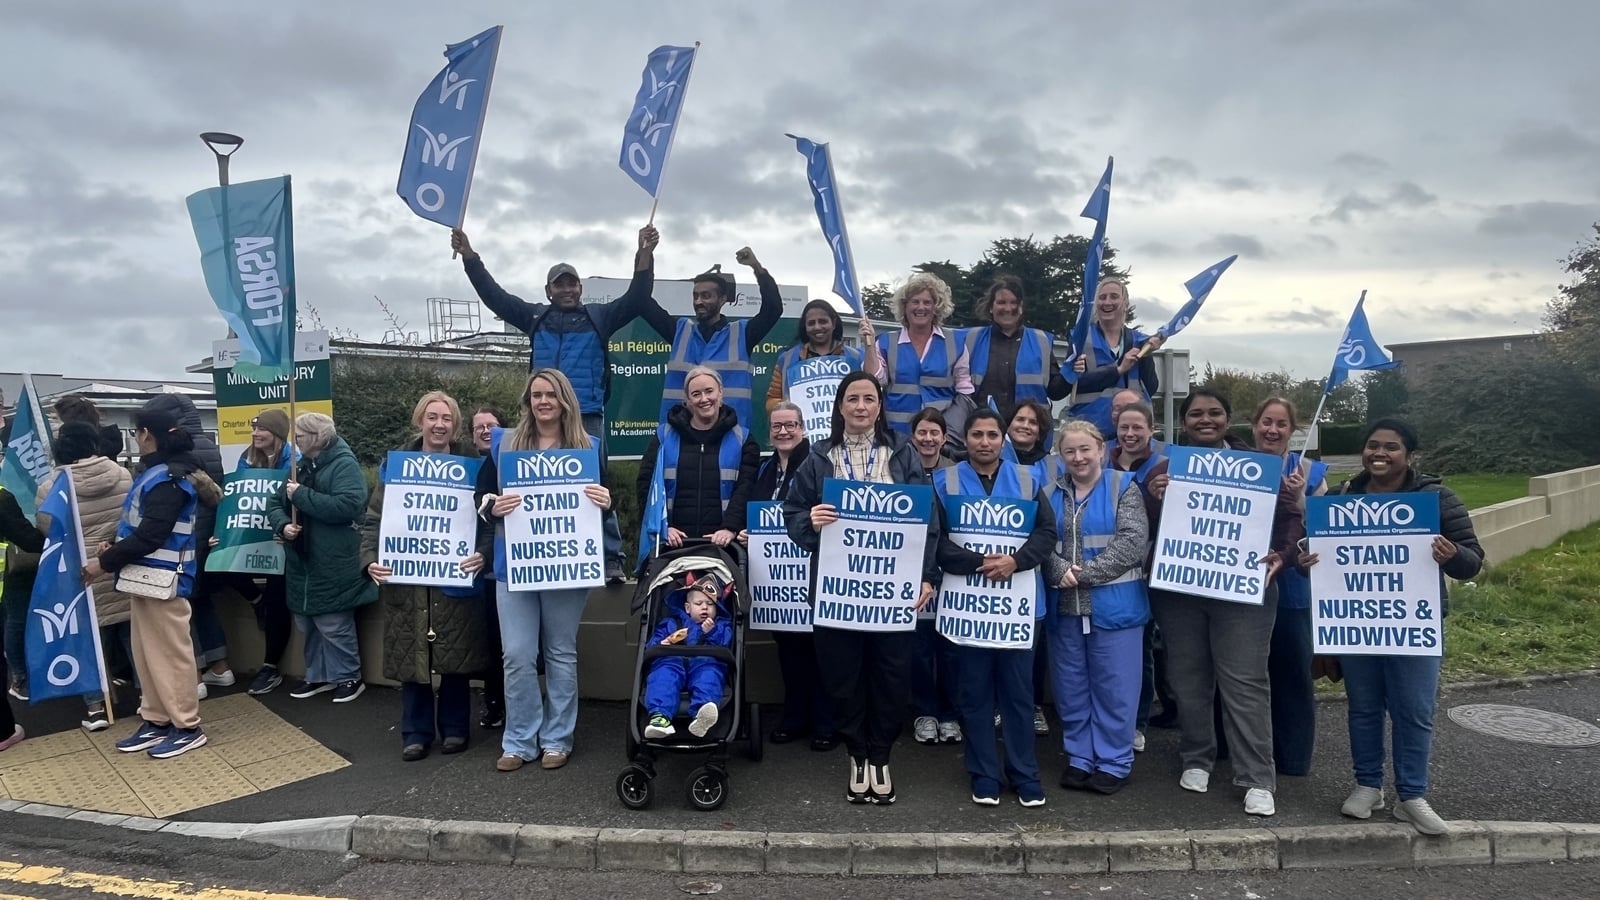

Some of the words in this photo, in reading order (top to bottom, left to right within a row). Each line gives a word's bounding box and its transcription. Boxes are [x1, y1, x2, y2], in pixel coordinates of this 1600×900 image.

[628, 341, 672, 354] Réigiún
[610, 364, 660, 377] Regional
[800, 359, 851, 378] INMO
[259, 385, 288, 400] UNIT
[806, 385, 838, 399] STAN
[812, 400, 834, 413] WI
[402, 454, 466, 481] INMO
[517, 452, 583, 479] INMO
[1188, 451, 1263, 481] INMO
[238, 496, 267, 511] ON
[403, 492, 458, 512] STAND
[523, 492, 580, 512] STAND
[841, 485, 913, 515] INMO
[1187, 491, 1252, 517] STAND
[960, 498, 1025, 528] INMO
[1329, 497, 1415, 527] INMO
[407, 515, 451, 534] WITH
[530, 516, 576, 535] WITH
[1191, 516, 1242, 541] WITH
[385, 537, 450, 556] NURSES
[456, 540, 469, 557] &
[511, 539, 578, 560] NURSES
[585, 538, 598, 556] &
[843, 528, 904, 550] STAND
[245, 548, 279, 570] FÓRSA
[848, 553, 896, 575] WITH
[1162, 538, 1239, 567] NURSES
[1245, 551, 1260, 571] &
[1336, 544, 1410, 566] STAND
[382, 559, 470, 580] MIDWIVES
[511, 562, 601, 585] MIDWIVES
[769, 564, 806, 581] WITH
[1156, 563, 1260, 595] MIDWIVES
[822, 576, 895, 600] NURSES
[901, 582, 914, 600] &
[1344, 572, 1404, 592] WITH
[753, 586, 808, 603] NURSES
[942, 590, 1012, 616] NURSES
[1018, 598, 1030, 616] &
[753, 607, 814, 625] MIDWIV
[818, 601, 915, 624] MIDWIVES
[1319, 599, 1407, 620] NURSES
[1415, 599, 1433, 620] &
[939, 615, 1031, 642] MIDWIVES
[1318, 626, 1437, 648] MIDWIVES
